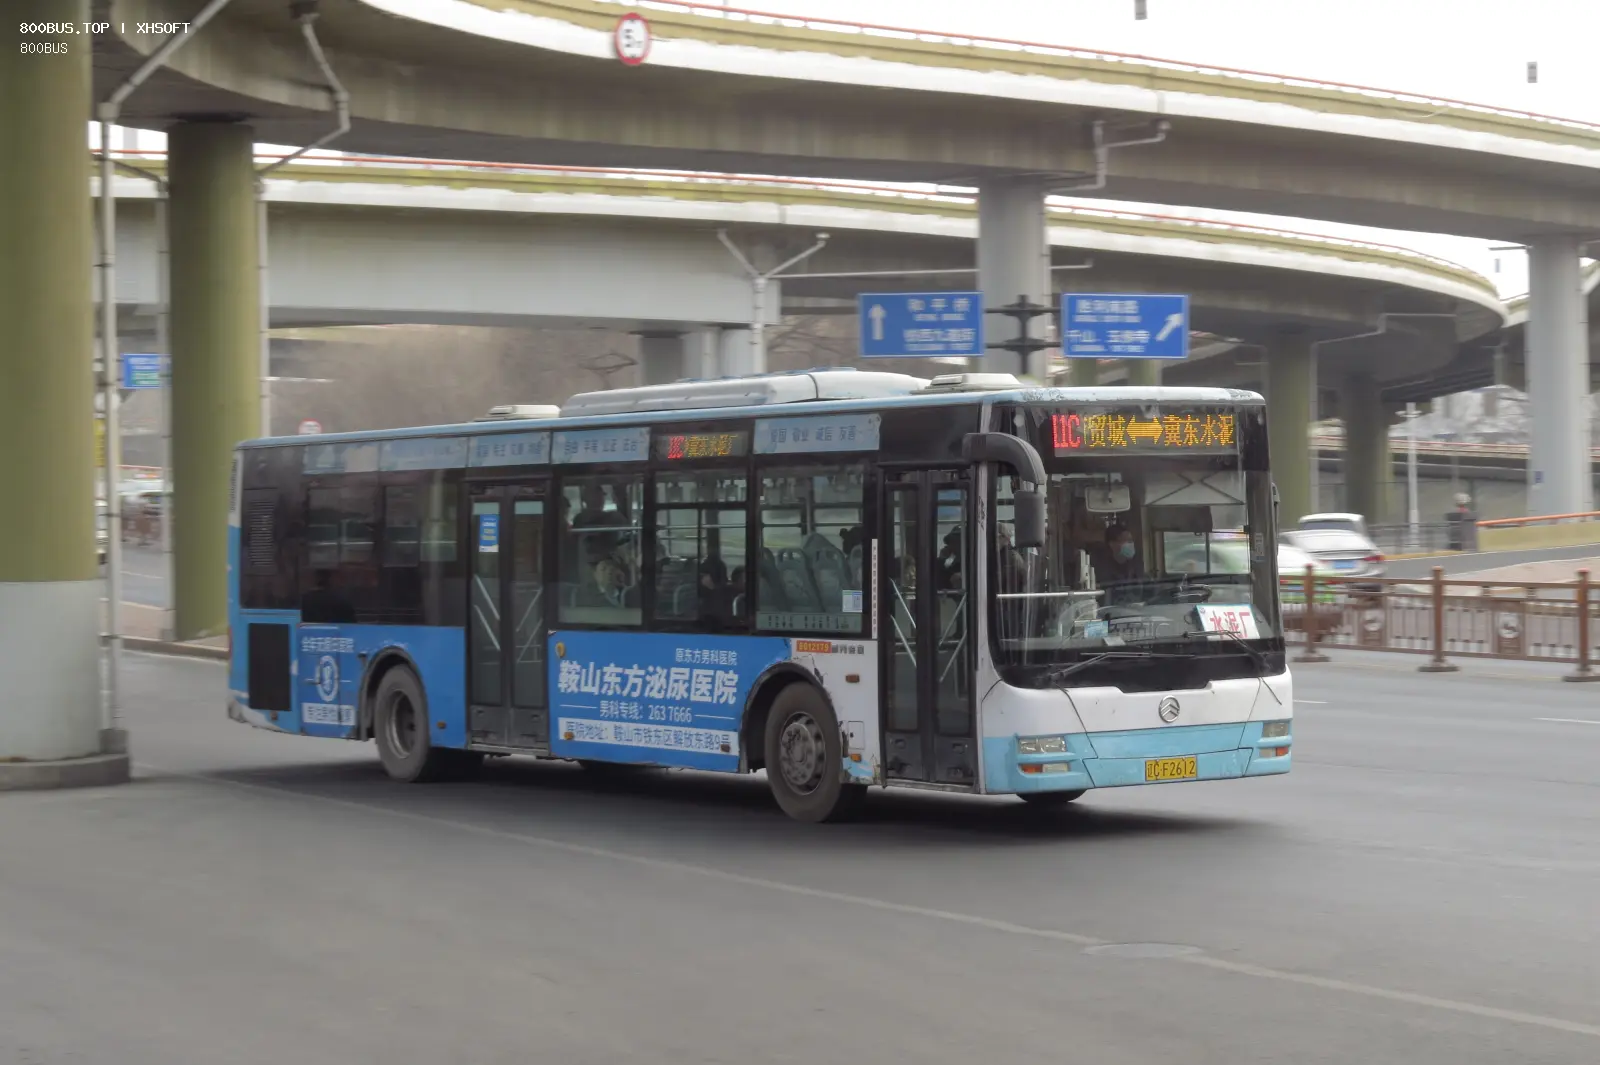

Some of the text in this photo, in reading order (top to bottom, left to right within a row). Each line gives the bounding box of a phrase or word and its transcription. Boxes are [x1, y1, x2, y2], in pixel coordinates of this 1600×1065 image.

[1083, 414, 1128, 447] 贸城
[1209, 609, 1251, 640] 水泥厂
[675, 647, 738, 666] 原东方男科医院
[557, 659, 739, 705] 鞍山东方泌尿医院
